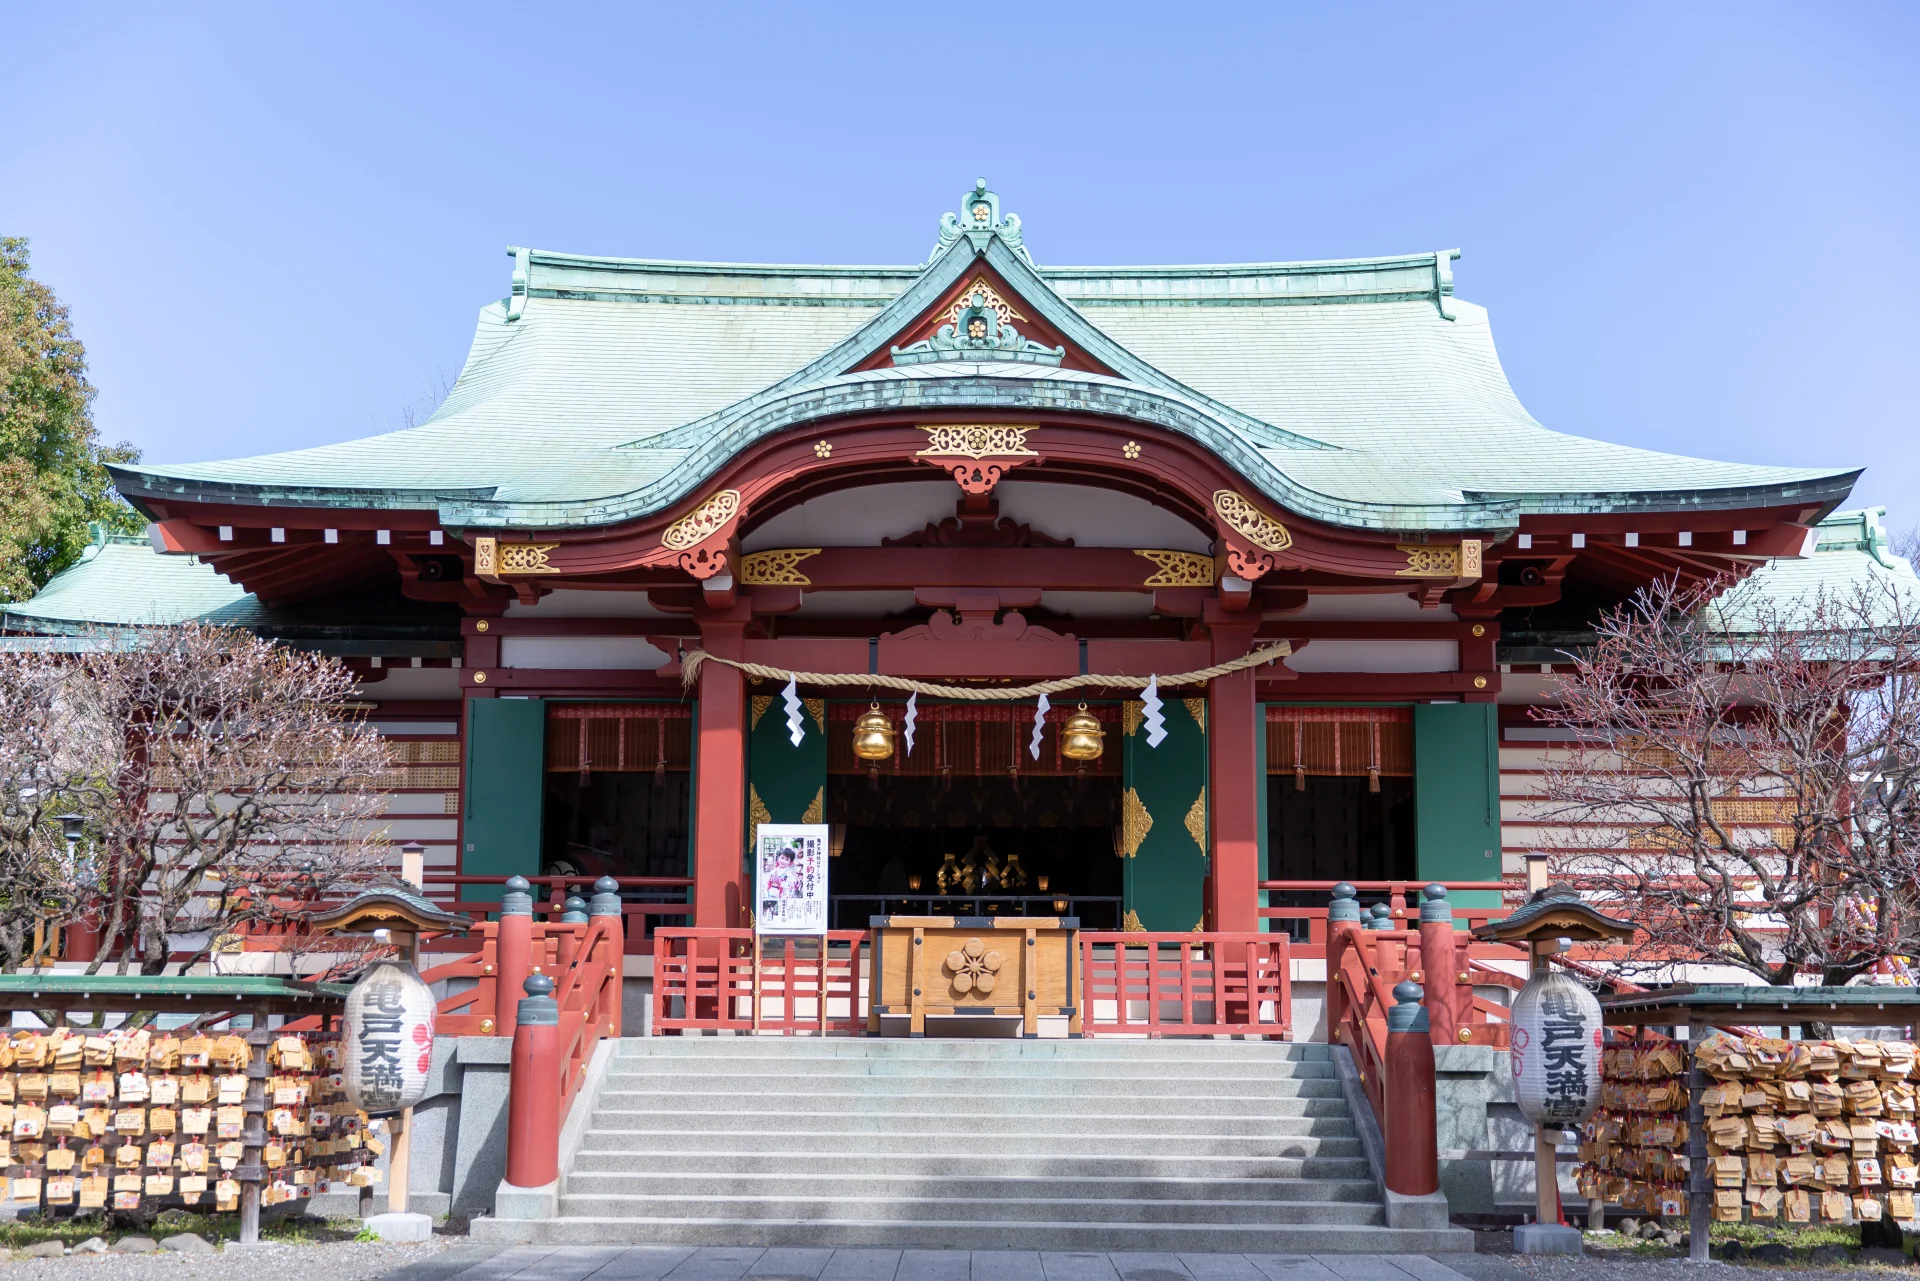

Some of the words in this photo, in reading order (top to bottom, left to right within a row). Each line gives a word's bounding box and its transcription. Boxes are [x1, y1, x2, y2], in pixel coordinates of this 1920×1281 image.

[806, 840, 815, 899] 撮影予約受付中
[358, 981, 406, 1107] 亀戸天満宮
[1540, 991, 1588, 1118] 亀戸天満宮
